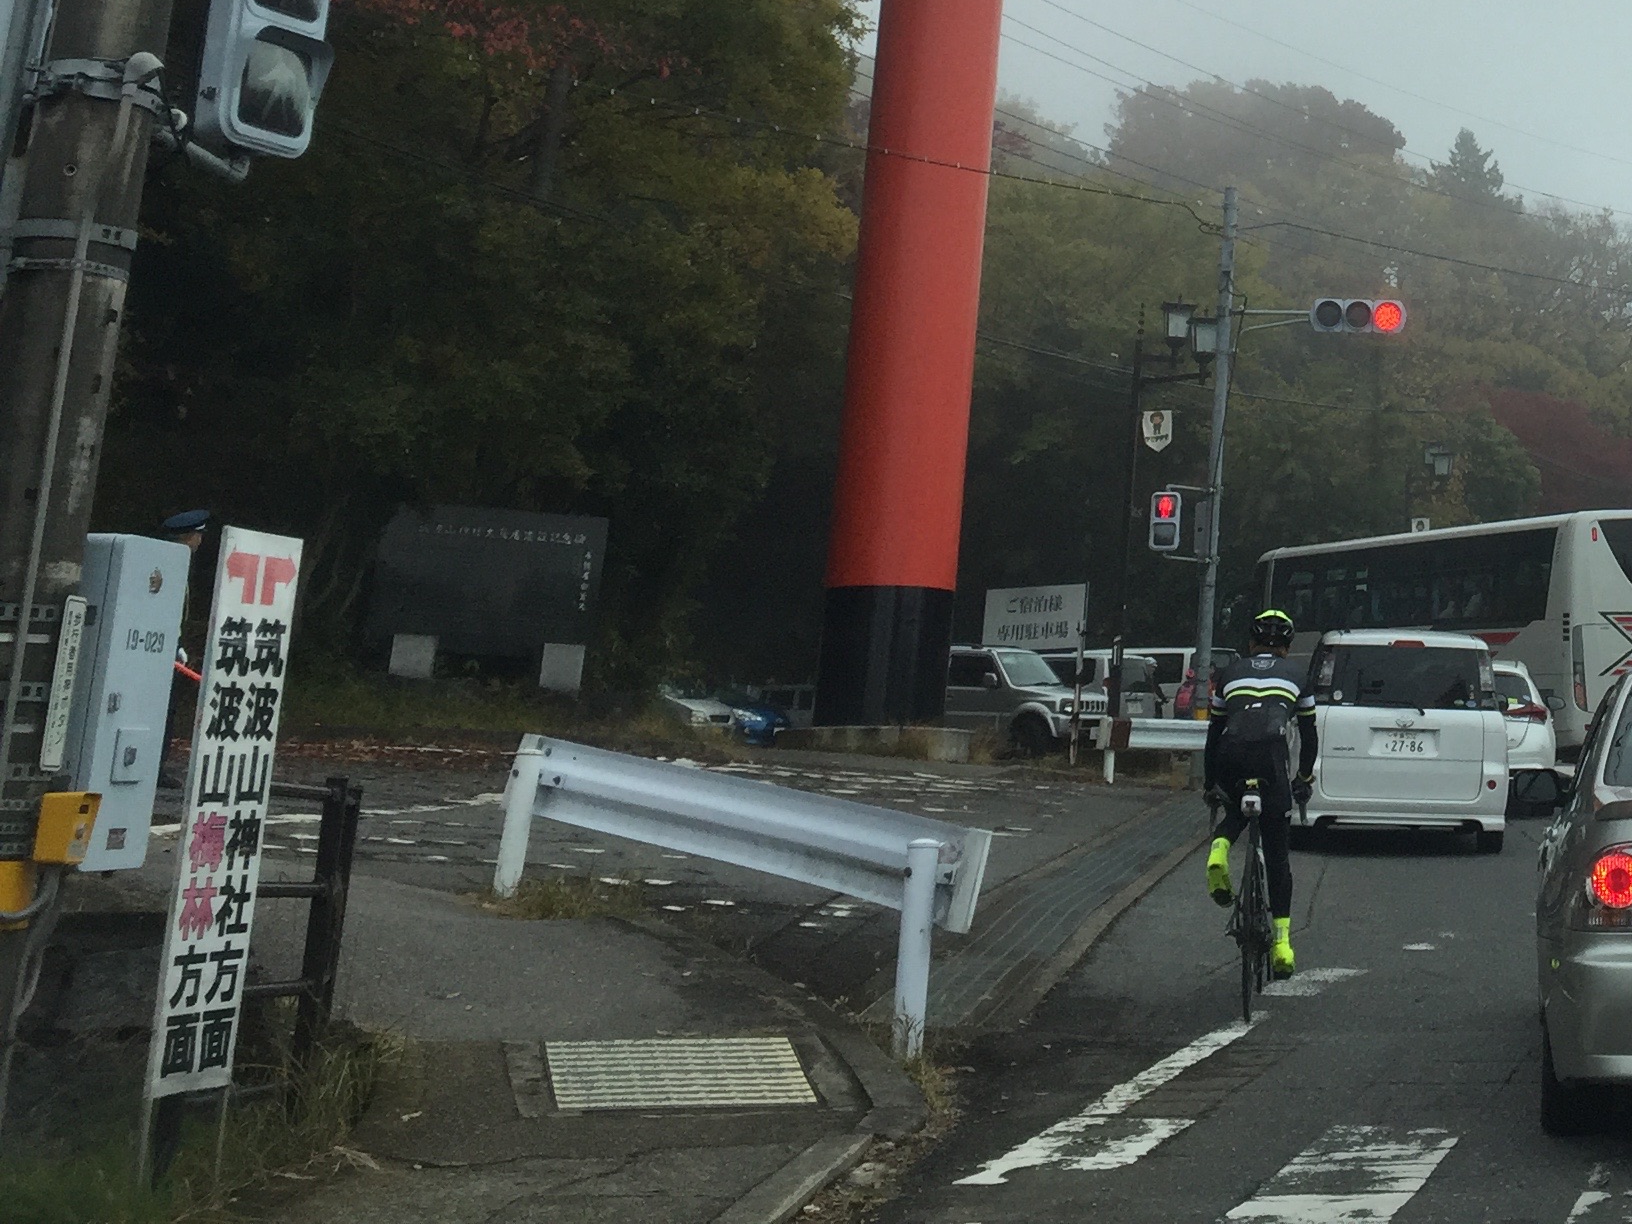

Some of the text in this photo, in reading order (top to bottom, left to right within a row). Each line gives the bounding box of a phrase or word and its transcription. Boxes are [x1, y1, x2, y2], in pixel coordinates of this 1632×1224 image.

[125, 628, 165, 654] 19-029
[1391, 740, 1424, 752] 27-86
[161, 616, 253, 1079] 筑波山梅林方面
[198, 618, 287, 1073] 筑波山神社方面
